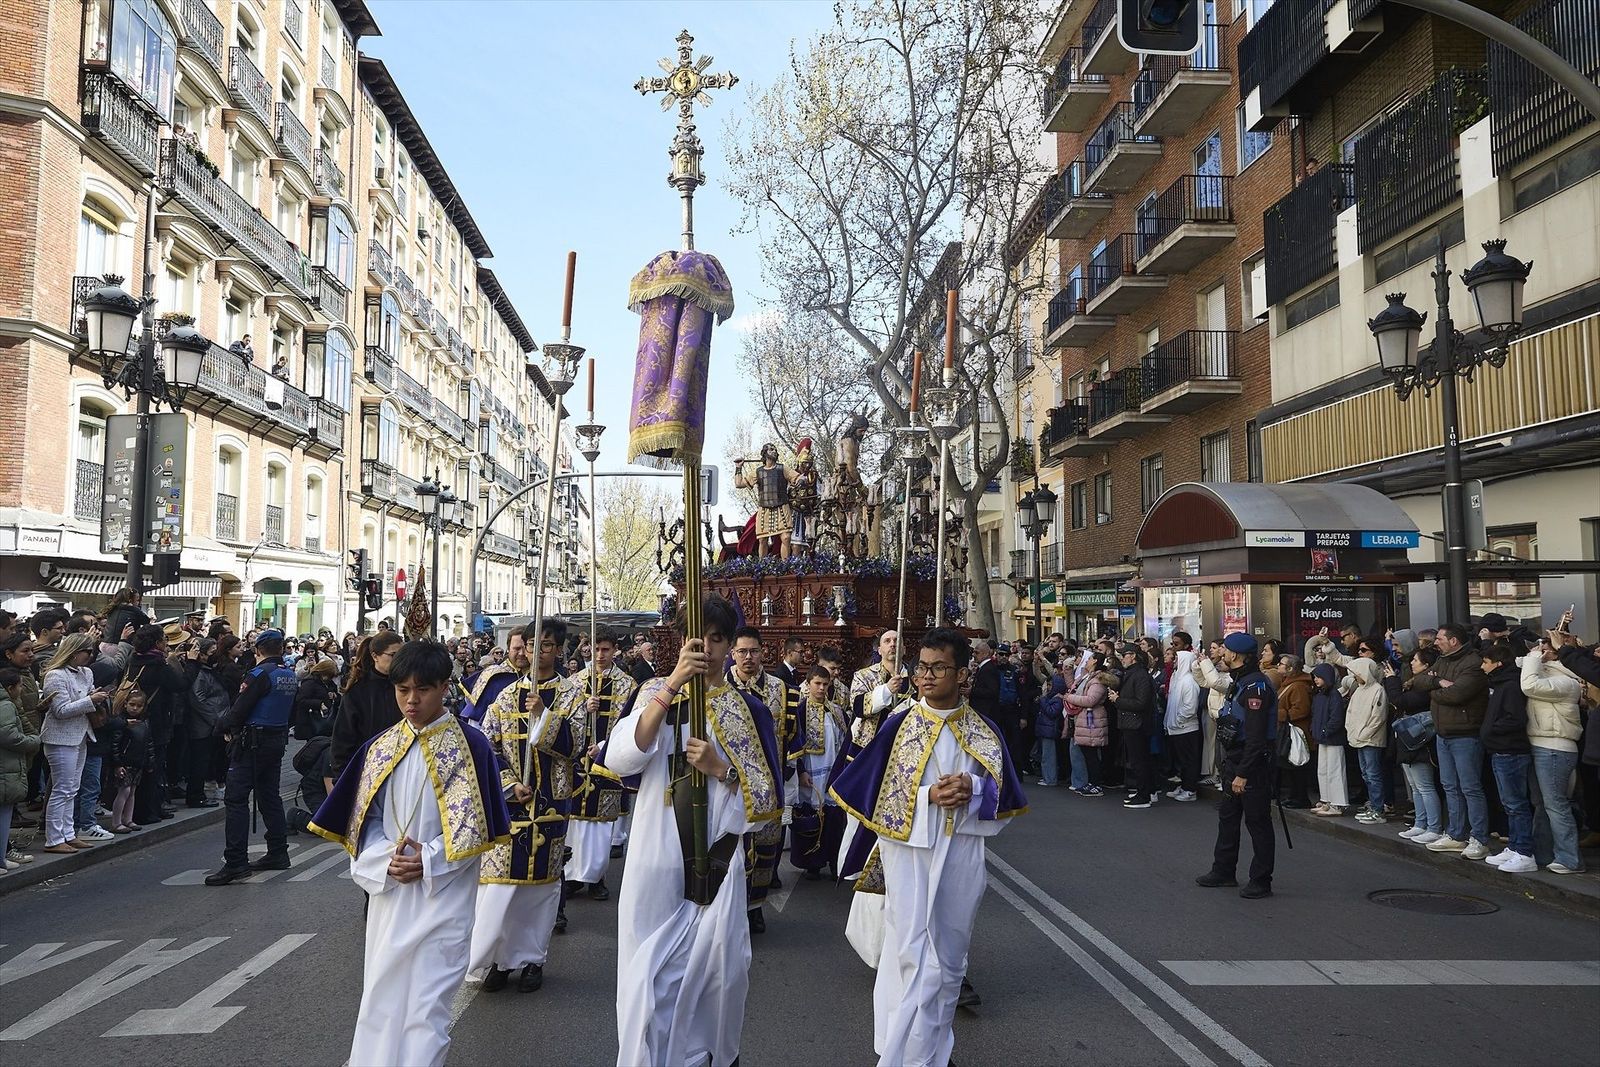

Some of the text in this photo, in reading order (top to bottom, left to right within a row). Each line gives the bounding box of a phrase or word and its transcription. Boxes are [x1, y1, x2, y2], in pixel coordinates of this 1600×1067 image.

[1449, 426, 1457, 447] 106
[23, 535, 58, 543] PANARIA
[1255, 535, 1295, 544] Lycamobile
[1372, 536, 1409, 545] LEBARA
[1120, 595, 1135, 603] ATM
[1303, 594, 1328, 604] AXN
[1301, 608, 1343, 620] Hay días
